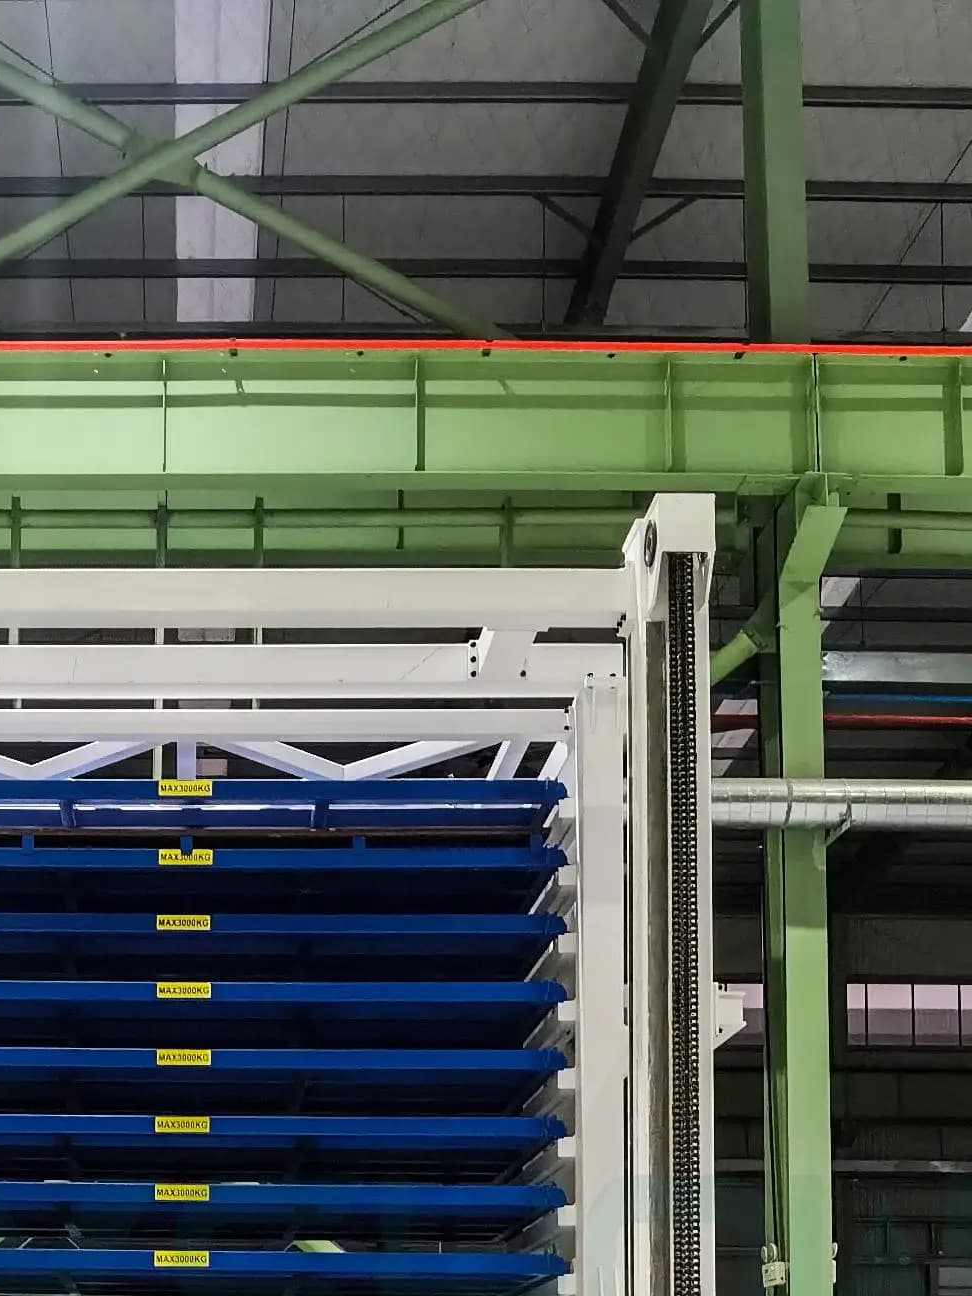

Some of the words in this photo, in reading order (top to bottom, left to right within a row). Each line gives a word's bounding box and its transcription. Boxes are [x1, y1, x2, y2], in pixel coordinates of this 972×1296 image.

[160, 784, 211, 793] MAX3000KG
[159, 918, 208, 927] MAX3000KG
[158, 986, 209, 995] MAX3000KG
[158, 1053, 209, 1062] MAX3000KG
[156, 1188, 207, 1197] MAX3000KG
[156, 1255, 207, 1264] MAX3000KG
